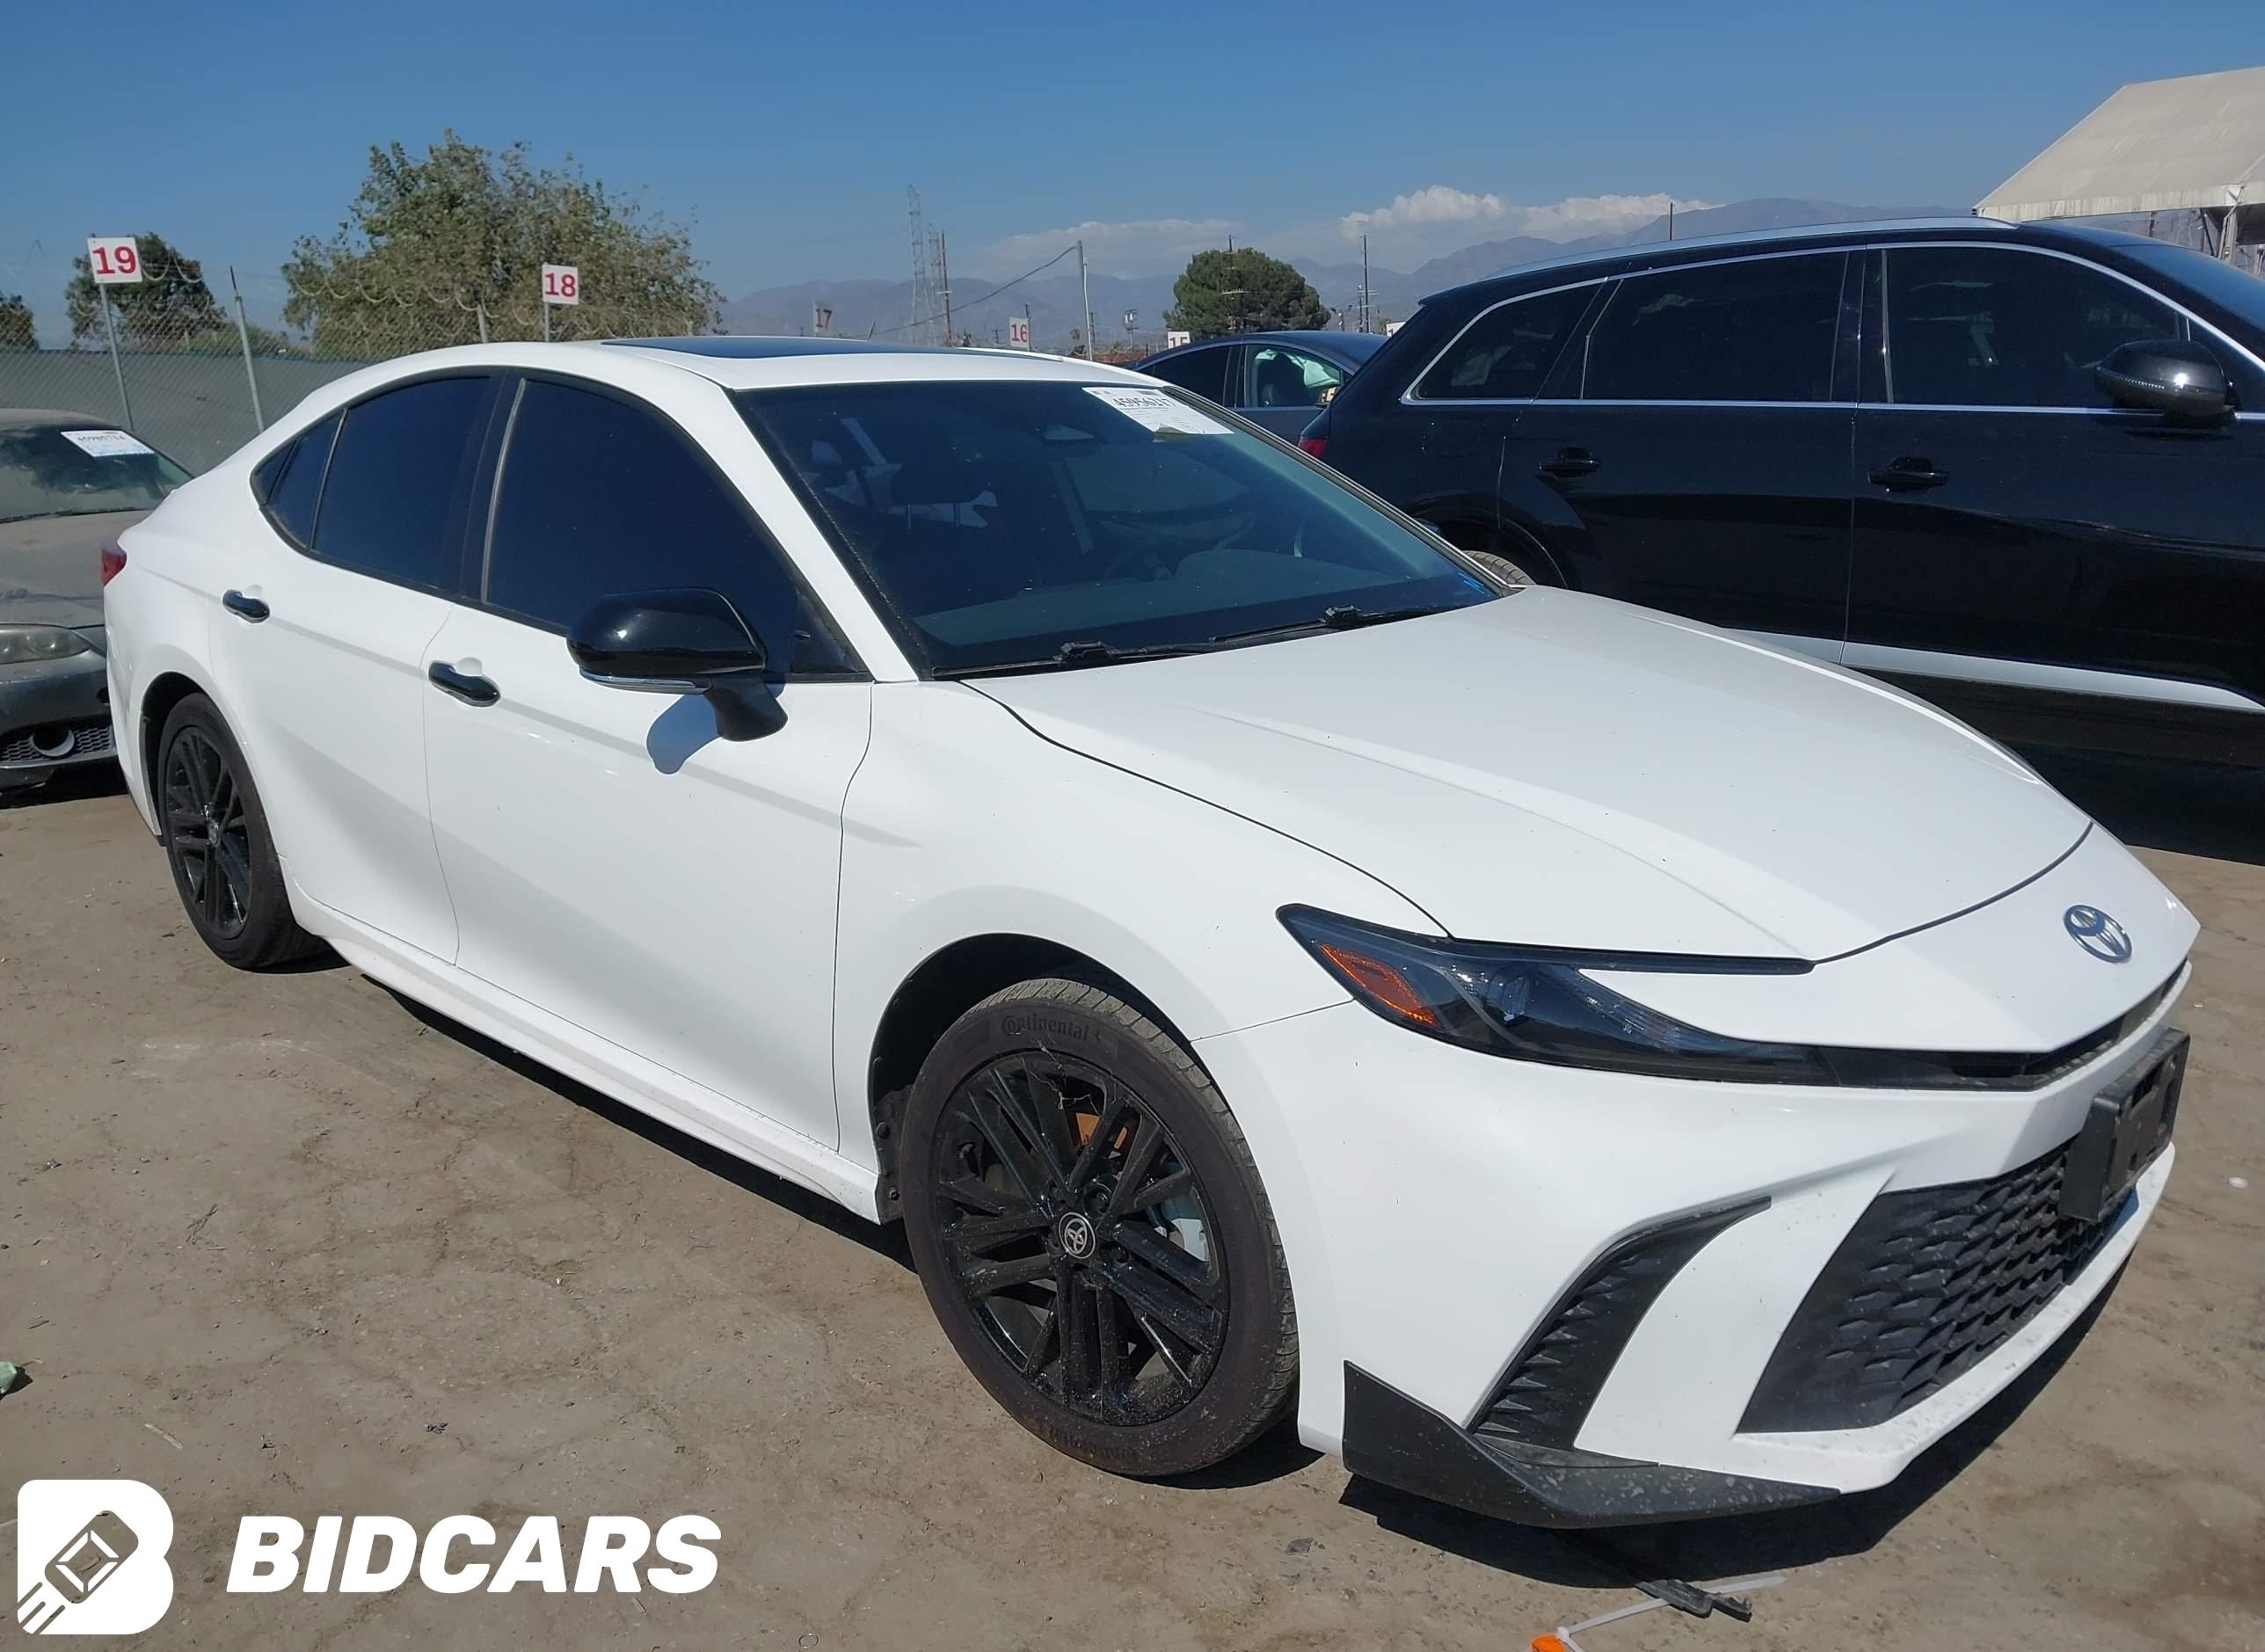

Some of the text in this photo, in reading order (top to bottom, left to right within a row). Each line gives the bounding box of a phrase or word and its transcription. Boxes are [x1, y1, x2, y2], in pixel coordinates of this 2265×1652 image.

[92, 245, 137, 275] 19
[544, 273, 576, 297] 18
[815, 308, 833, 330] 17
[1011, 324, 1028, 343] 16
[1001, 1012, 1089, 1042] Continental
